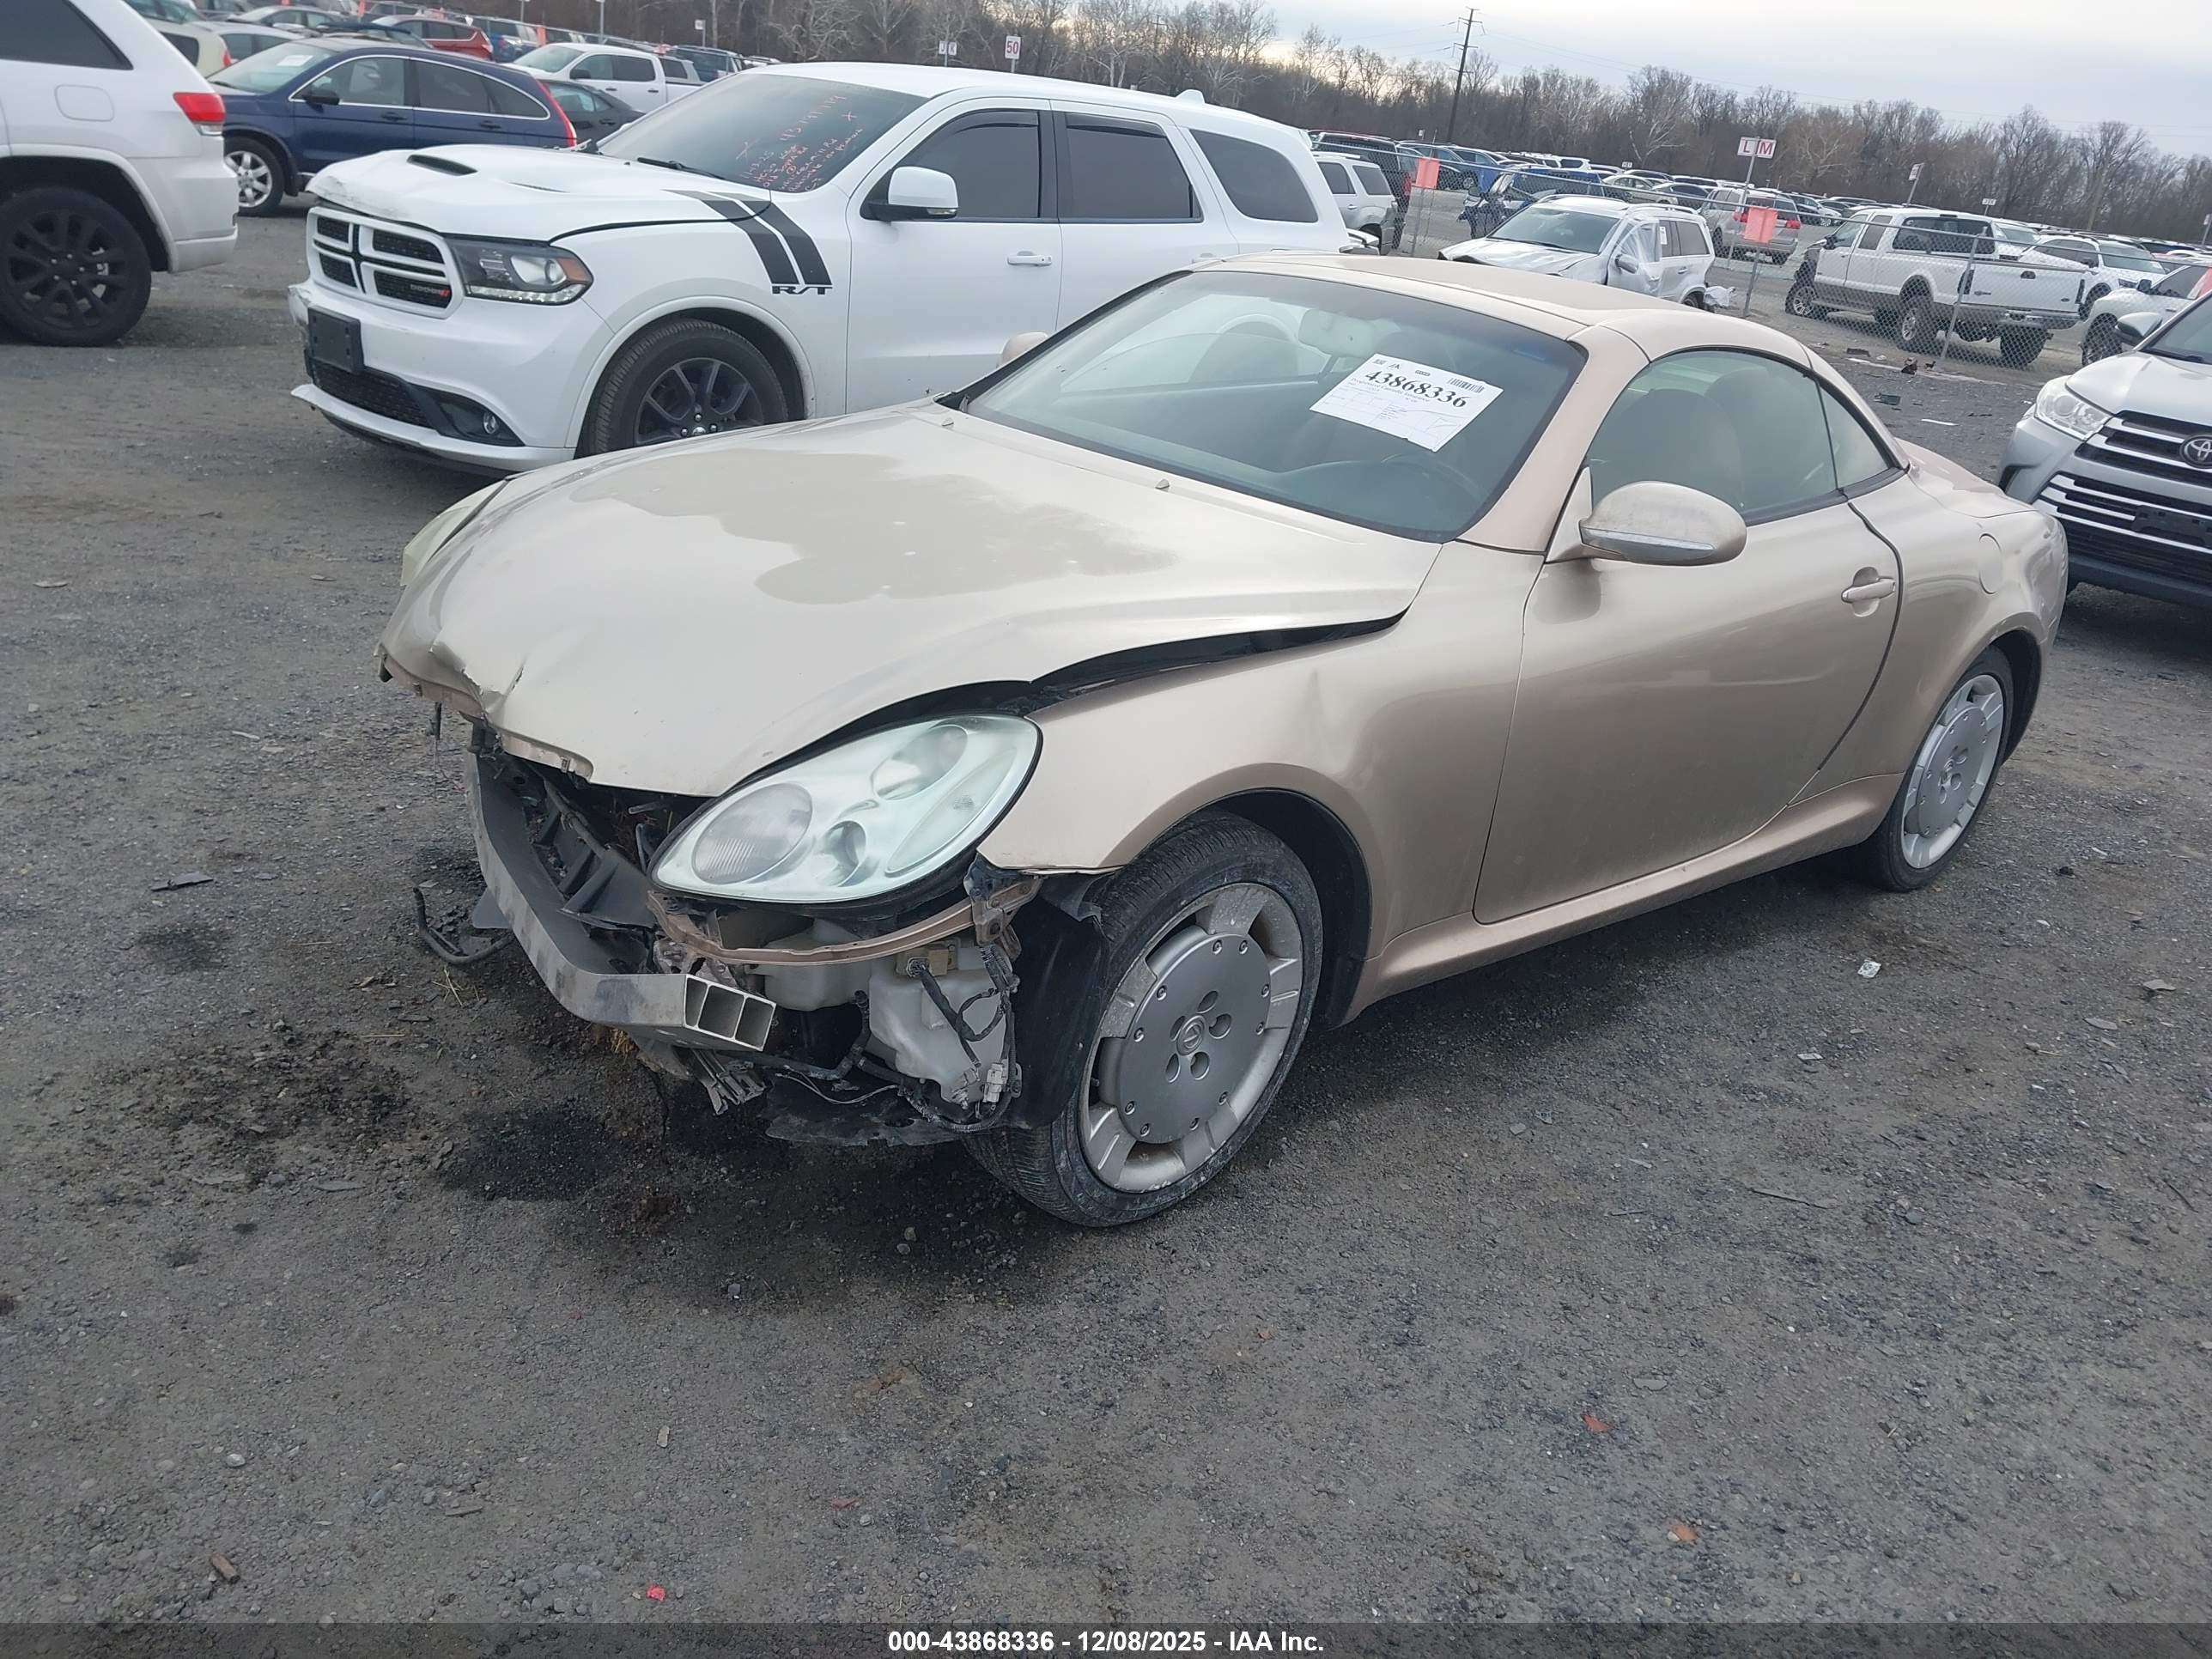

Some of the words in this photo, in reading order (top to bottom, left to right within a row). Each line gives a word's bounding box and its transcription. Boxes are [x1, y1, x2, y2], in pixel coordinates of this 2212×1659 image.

[1006, 41, 1019, 54] 50
[1743, 140, 1751, 153] L
[1759, 143, 1773, 155] M
[1364, 370, 1473, 408] 43868336
